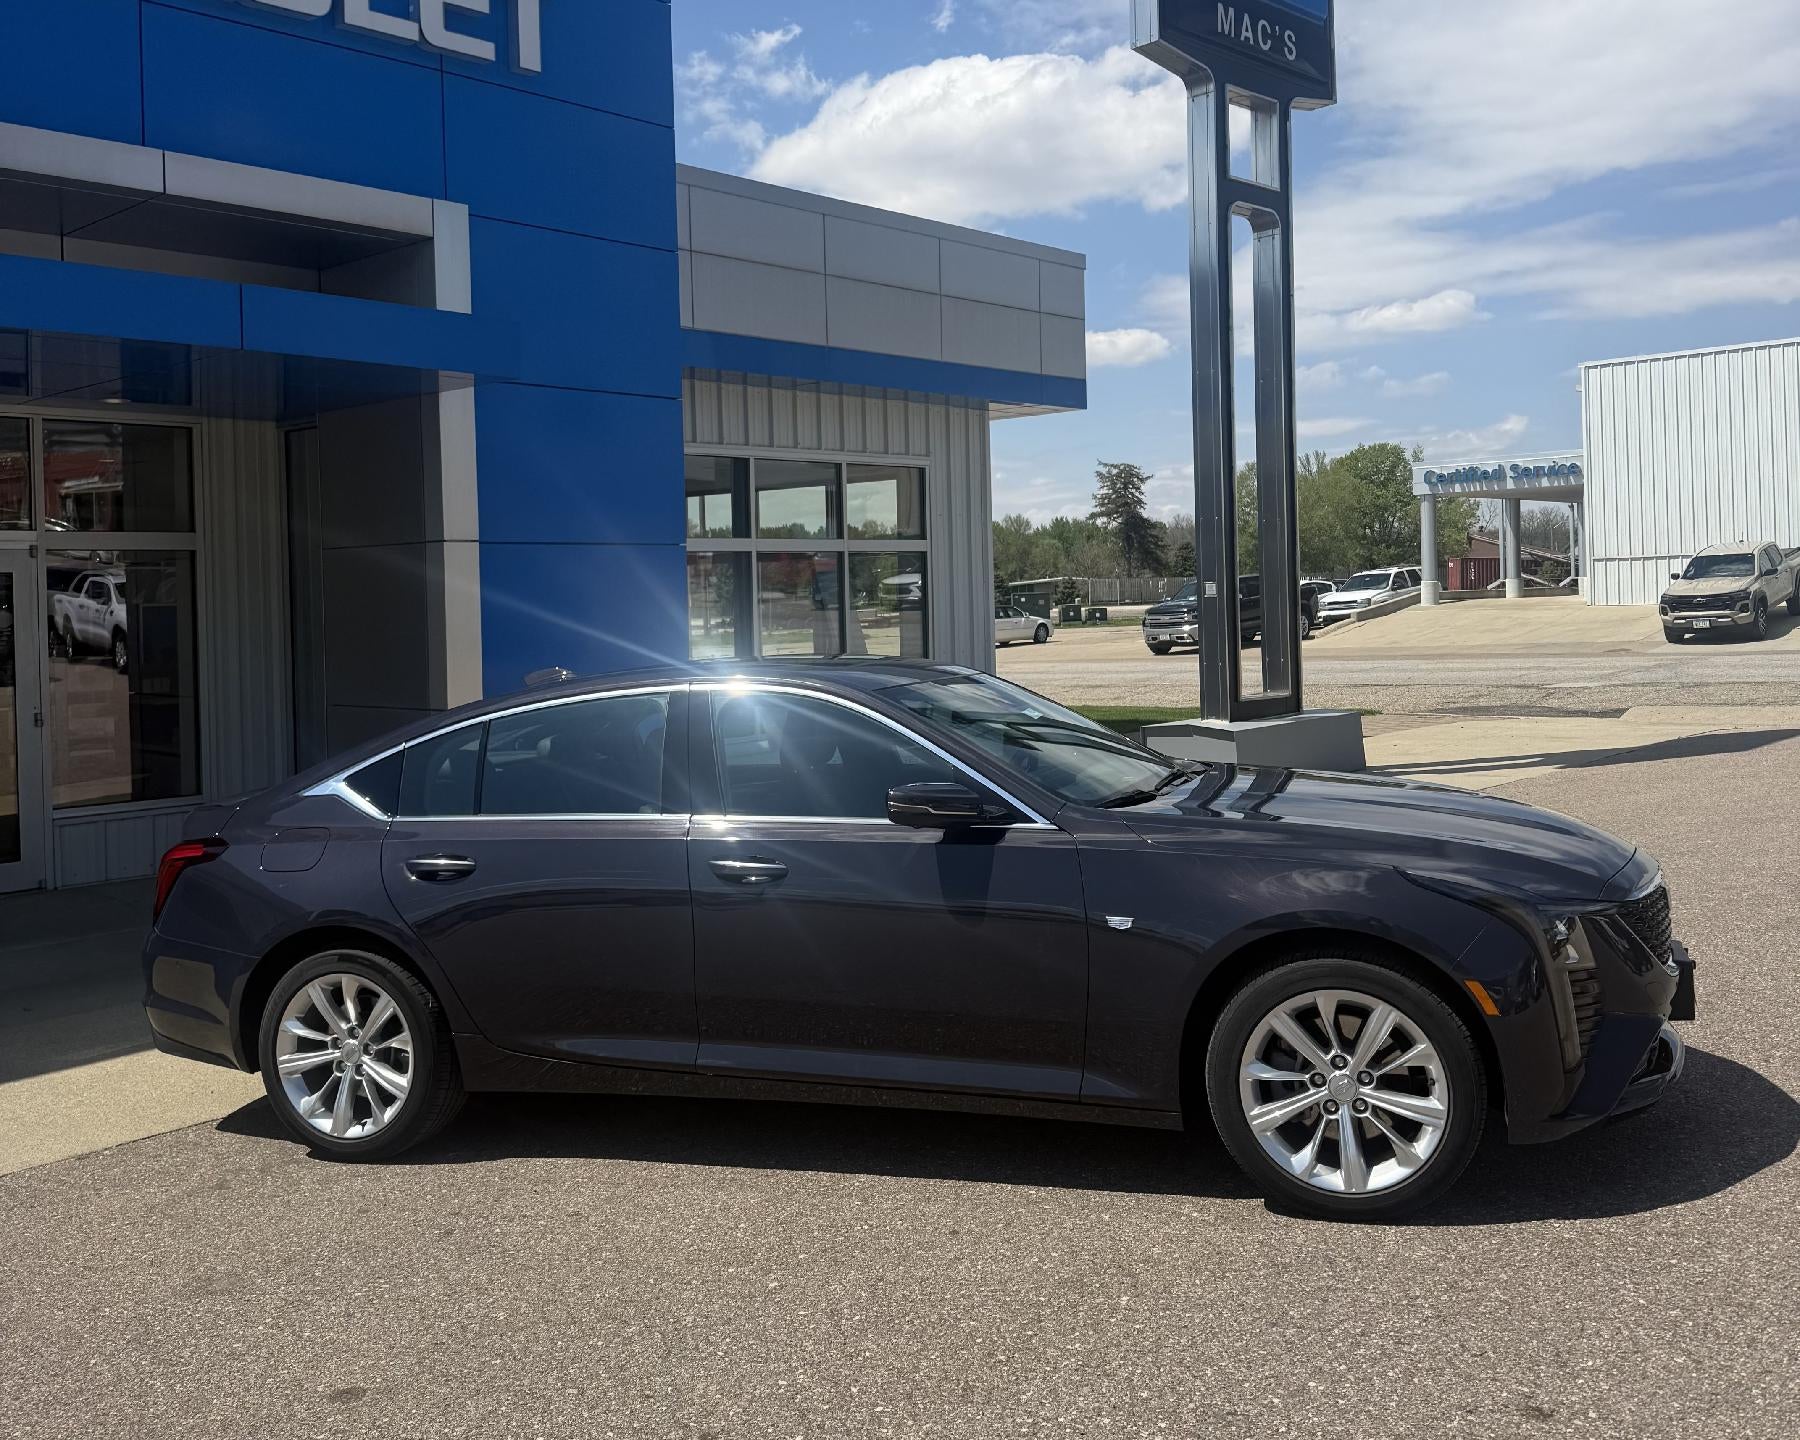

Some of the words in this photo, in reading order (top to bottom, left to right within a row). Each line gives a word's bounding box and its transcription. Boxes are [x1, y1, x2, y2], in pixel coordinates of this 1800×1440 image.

[1217, 2, 1297, 61] MAC'S
[1423, 464, 1507, 486] Certified
[1509, 461, 1583, 480] Service
